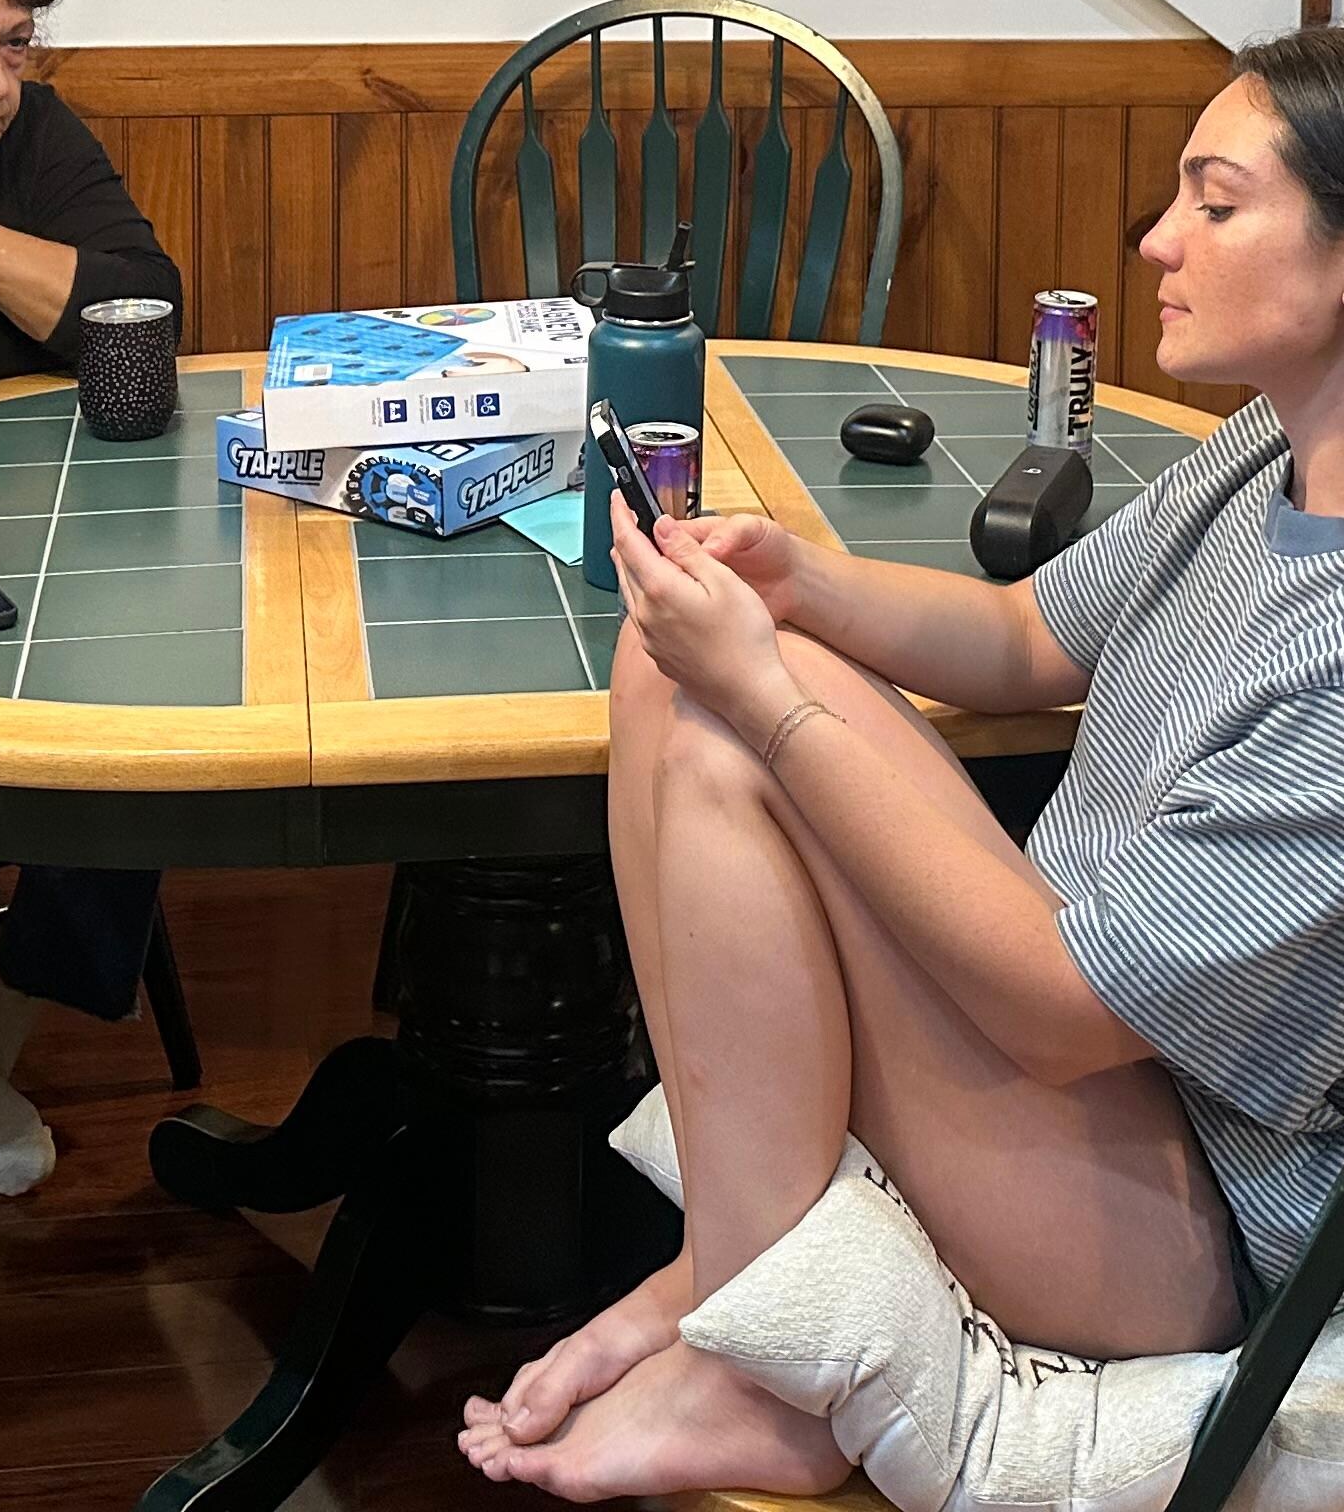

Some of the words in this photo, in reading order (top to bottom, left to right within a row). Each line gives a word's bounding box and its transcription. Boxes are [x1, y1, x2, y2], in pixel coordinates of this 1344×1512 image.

[539, 299, 584, 342] MAGNETIC
[1067, 346, 1094, 437] TRULY
[236, 448, 325, 480] TAPPLE
[467, 439, 554, 519] TAPPLE
